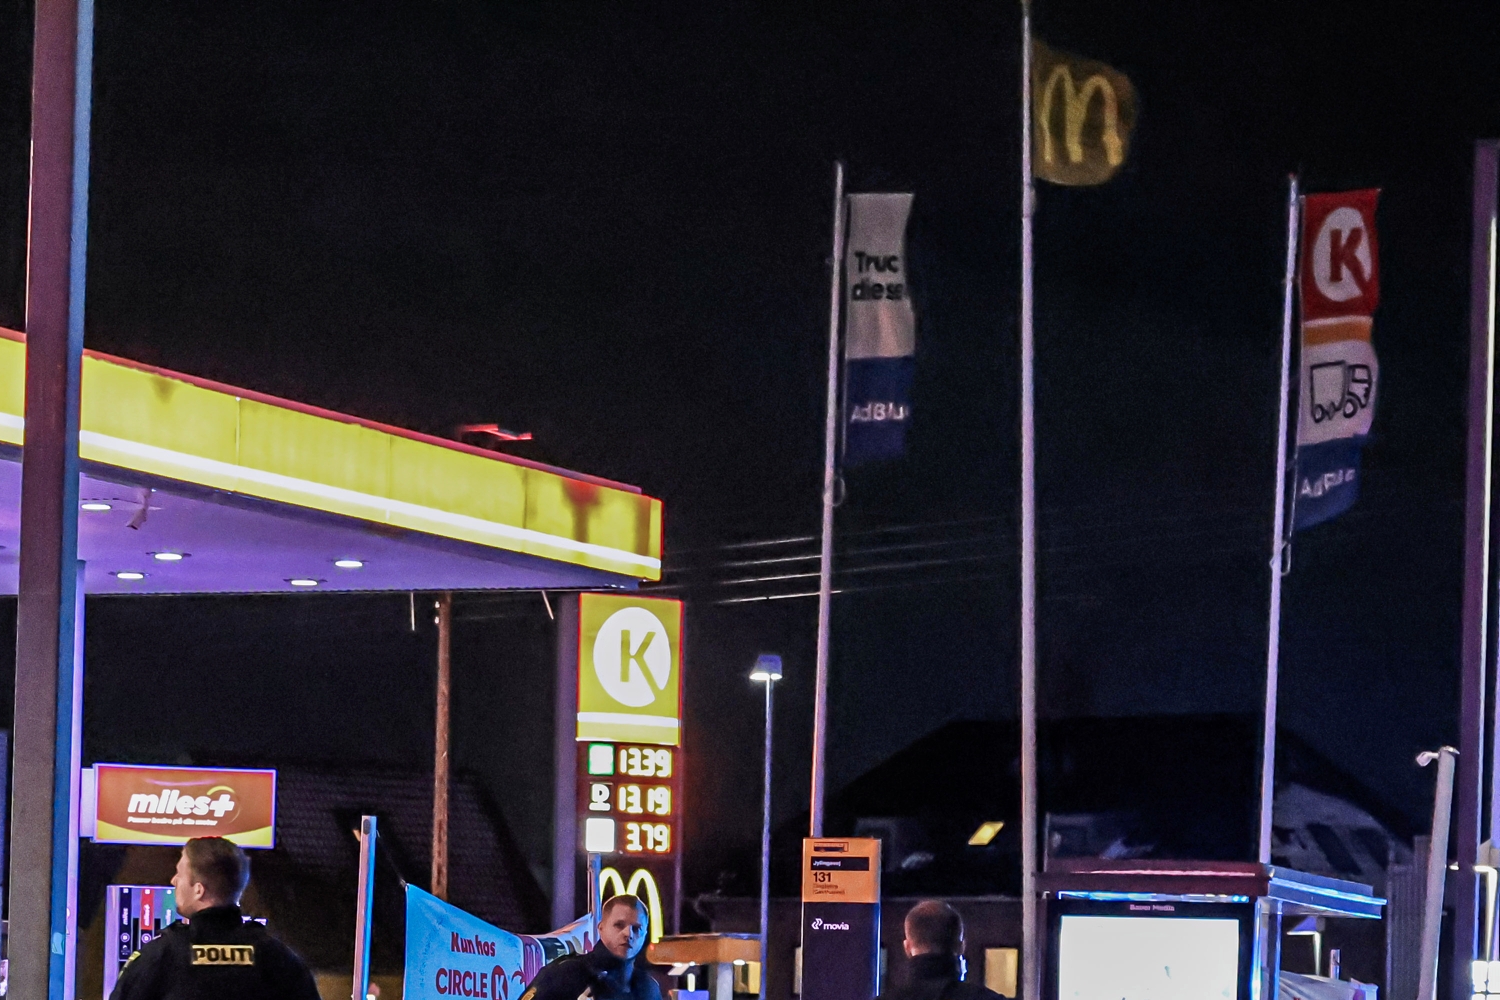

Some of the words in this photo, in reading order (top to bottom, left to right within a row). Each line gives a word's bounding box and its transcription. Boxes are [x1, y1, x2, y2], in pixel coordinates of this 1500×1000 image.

[854, 250, 899, 273] Truc
[850, 401, 907, 423] AdBlu
[813, 871, 831, 883] 131
[823, 921, 850, 931] movia
[451, 931, 474, 955] Kun
[474, 934, 496, 958] hos
[435, 967, 488, 999] CIRCLE
